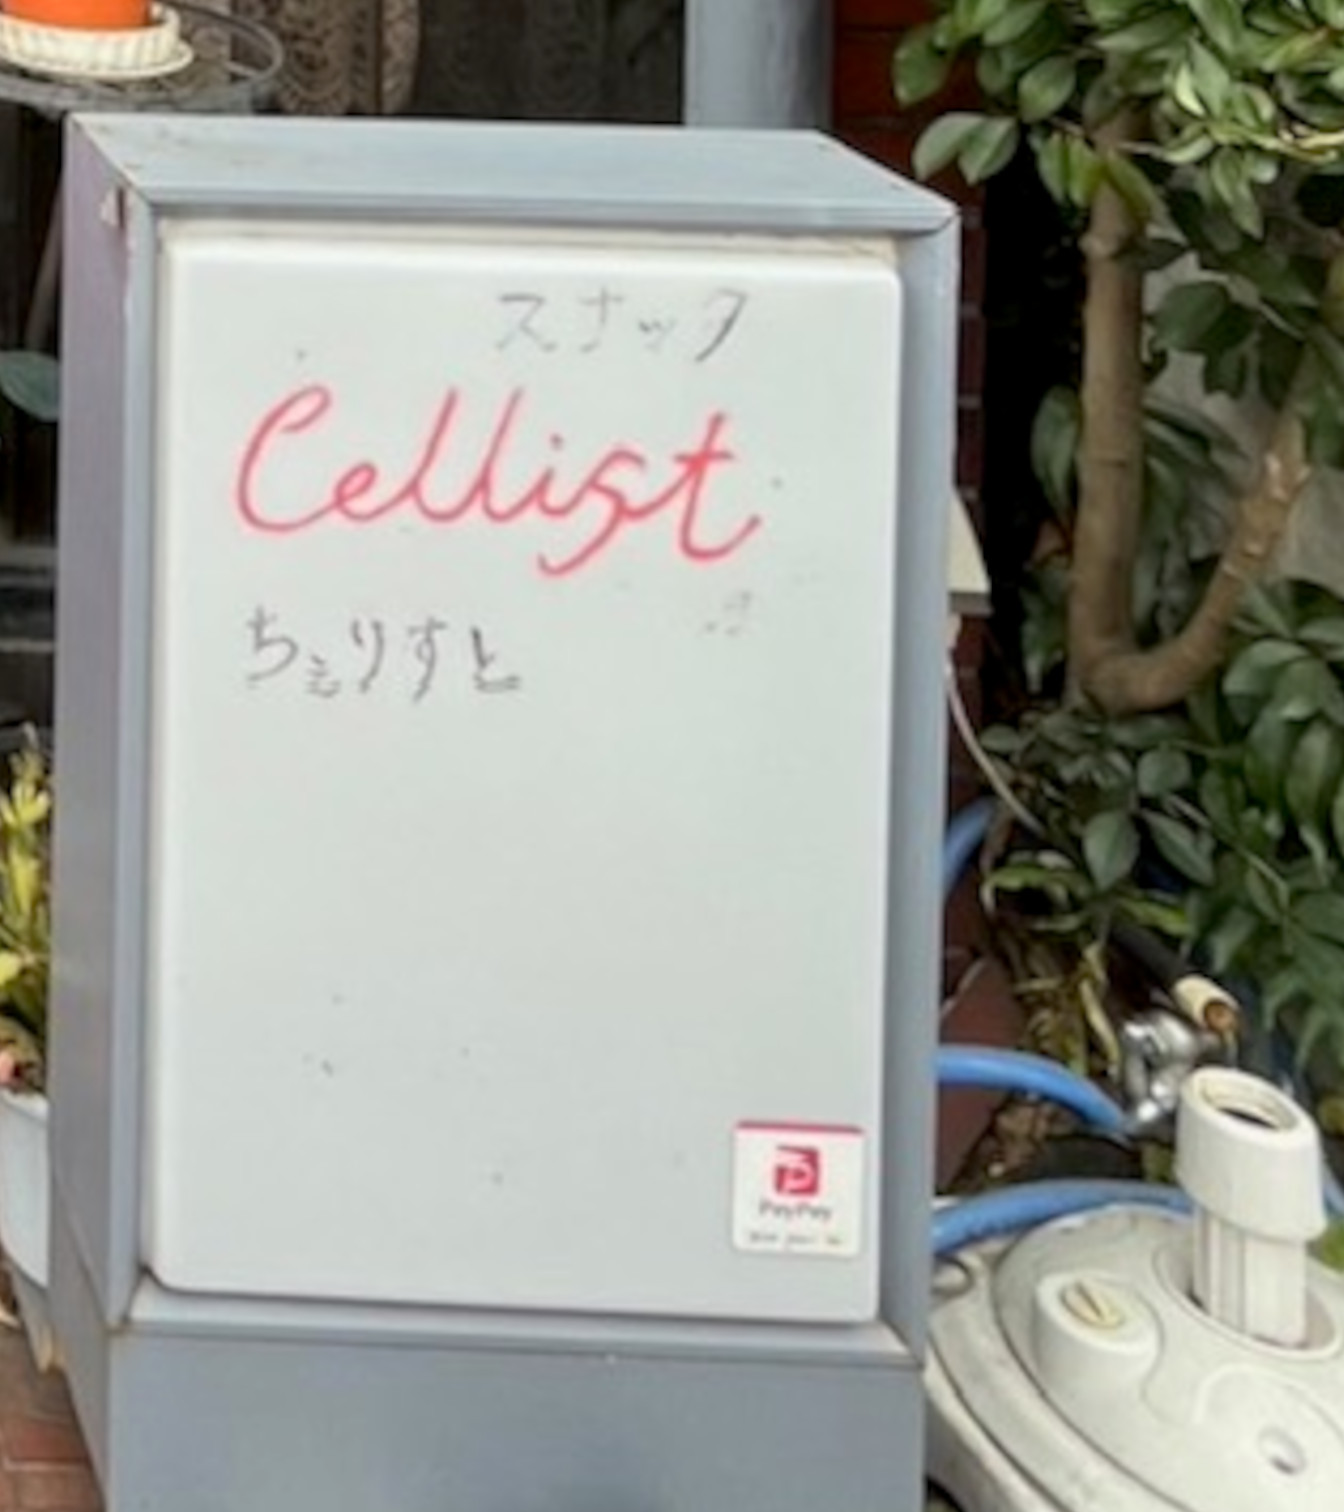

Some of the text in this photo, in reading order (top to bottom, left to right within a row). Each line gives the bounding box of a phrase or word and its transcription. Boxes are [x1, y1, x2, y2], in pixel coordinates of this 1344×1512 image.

[495, 288, 748, 364] スナック
[235, 382, 762, 578] Cellist
[244, 604, 522, 704] ちぇりすと
